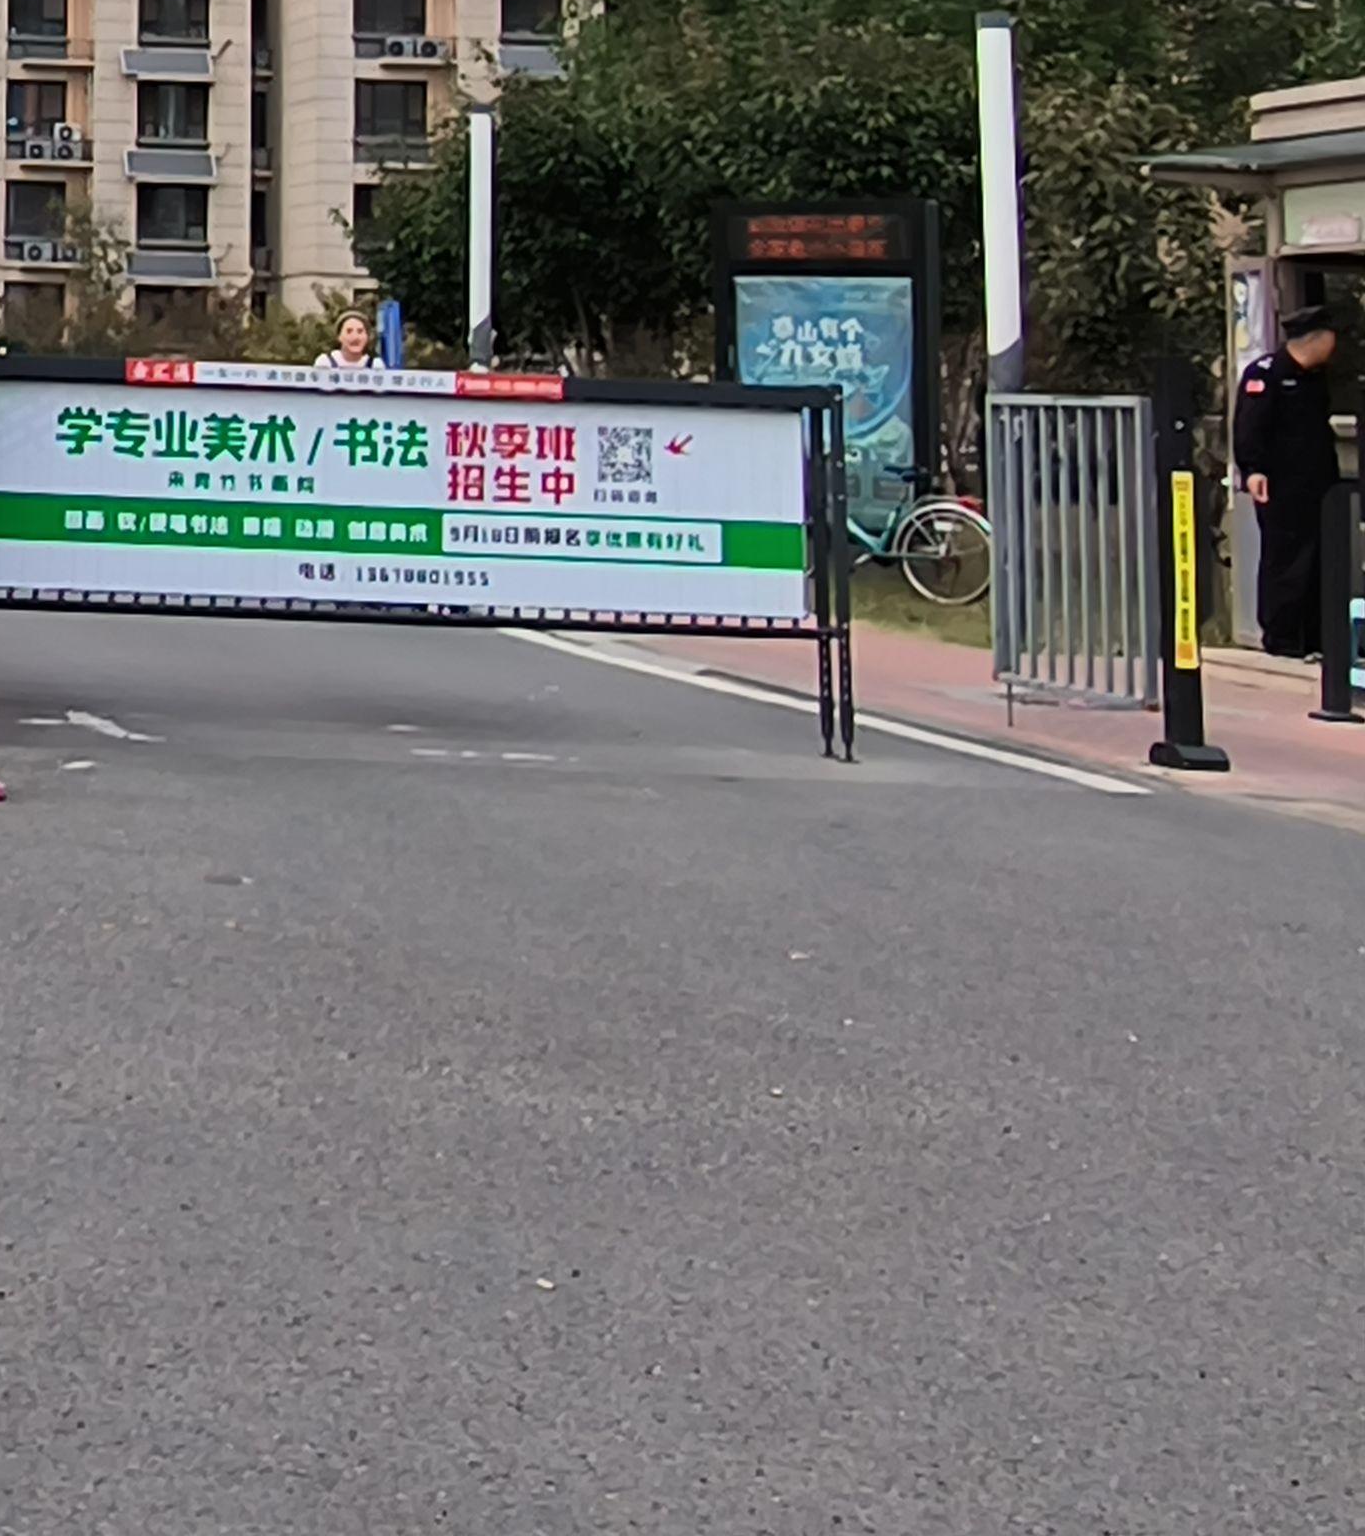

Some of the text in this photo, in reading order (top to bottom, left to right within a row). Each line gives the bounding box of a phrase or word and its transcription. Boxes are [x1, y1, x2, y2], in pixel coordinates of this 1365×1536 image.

[445, 421, 577, 462] 秋季班
[447, 463, 575, 505] 招生中
[298, 562, 336, 581] 电话
